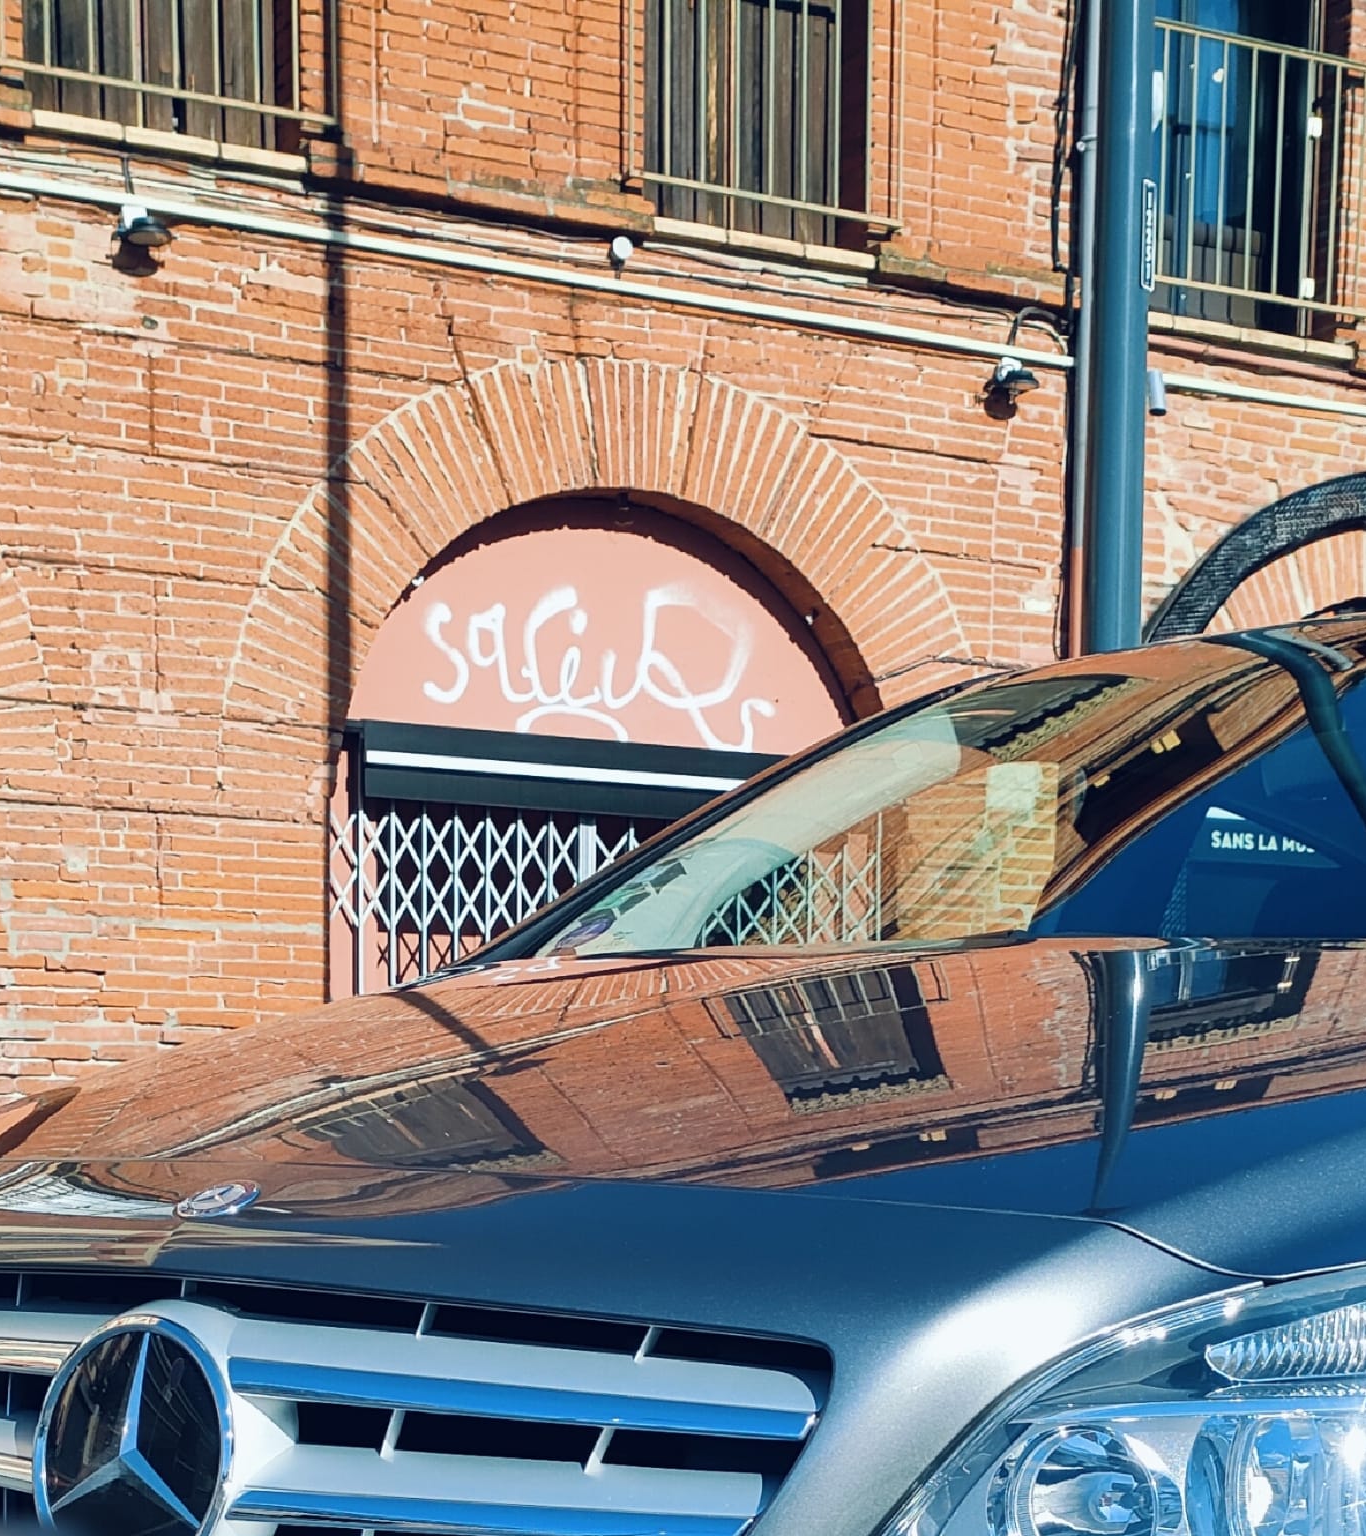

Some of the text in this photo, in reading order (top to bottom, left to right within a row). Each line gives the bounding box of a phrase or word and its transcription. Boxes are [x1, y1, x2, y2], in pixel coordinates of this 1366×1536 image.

[1211, 830, 1316, 853] SANS LA MU
